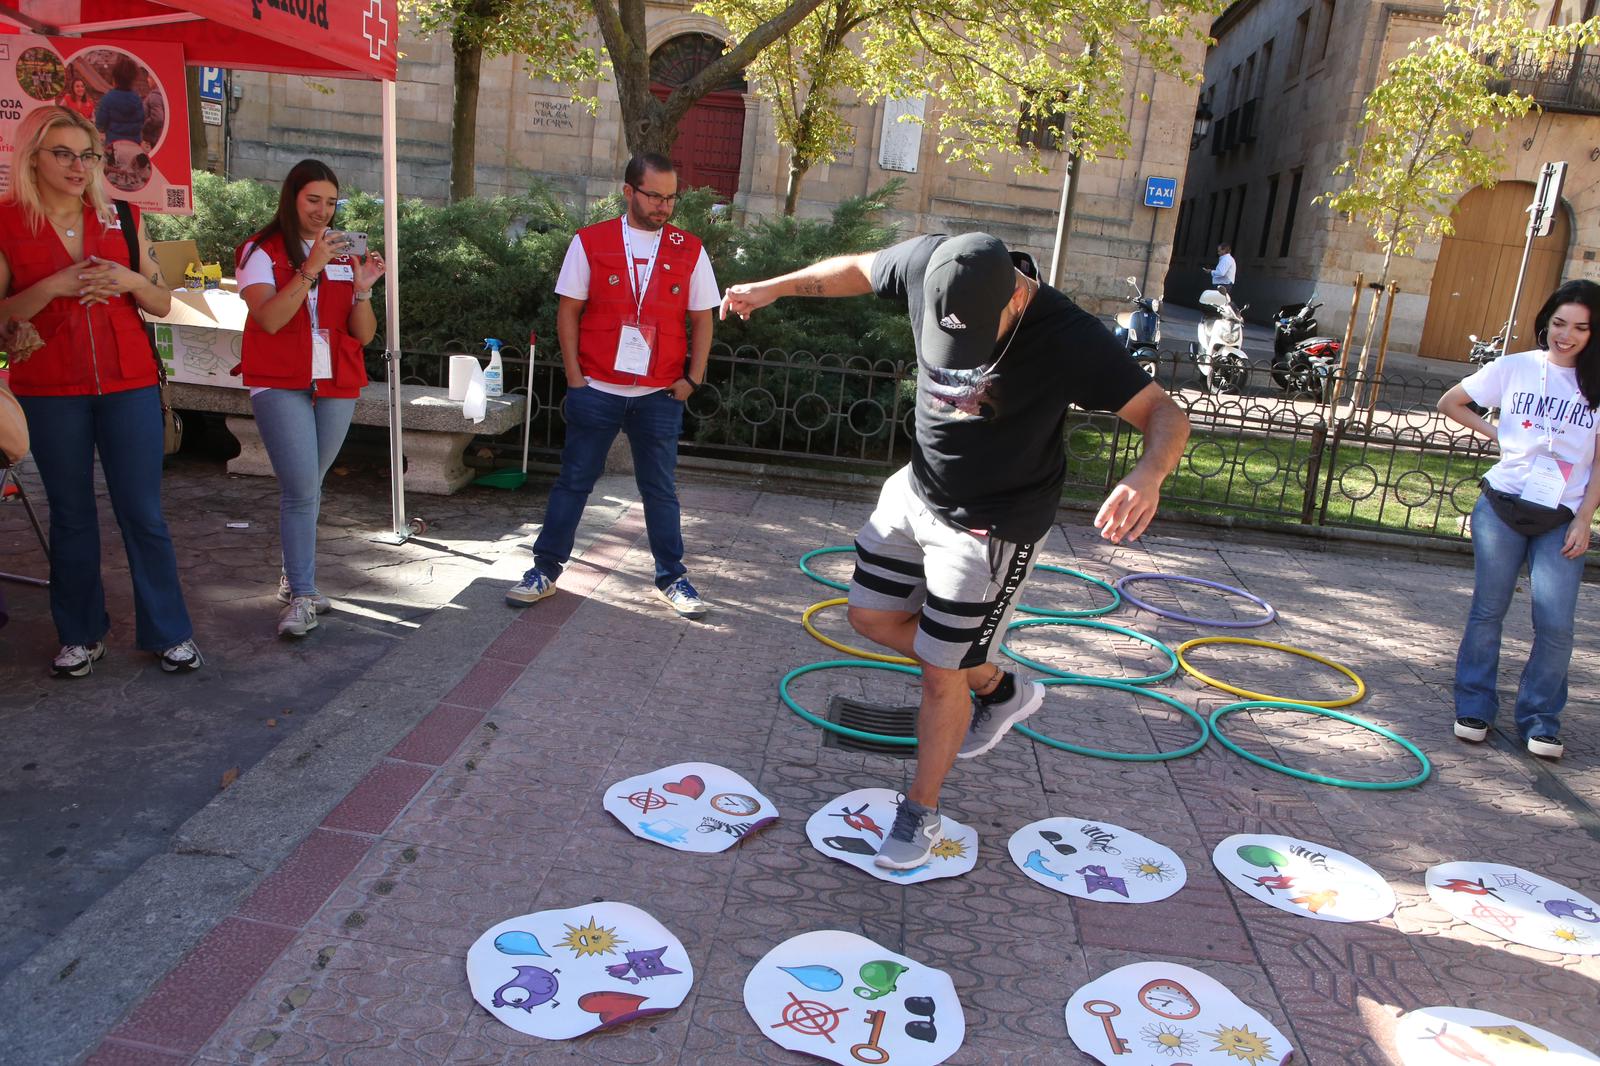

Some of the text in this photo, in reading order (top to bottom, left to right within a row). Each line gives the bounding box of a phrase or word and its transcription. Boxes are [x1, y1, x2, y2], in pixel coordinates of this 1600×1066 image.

[203, 66, 219, 92] P
[1149, 186, 1174, 198] TAXI
[939, 320, 967, 330] adidas
[1510, 391, 1535, 415] SER
